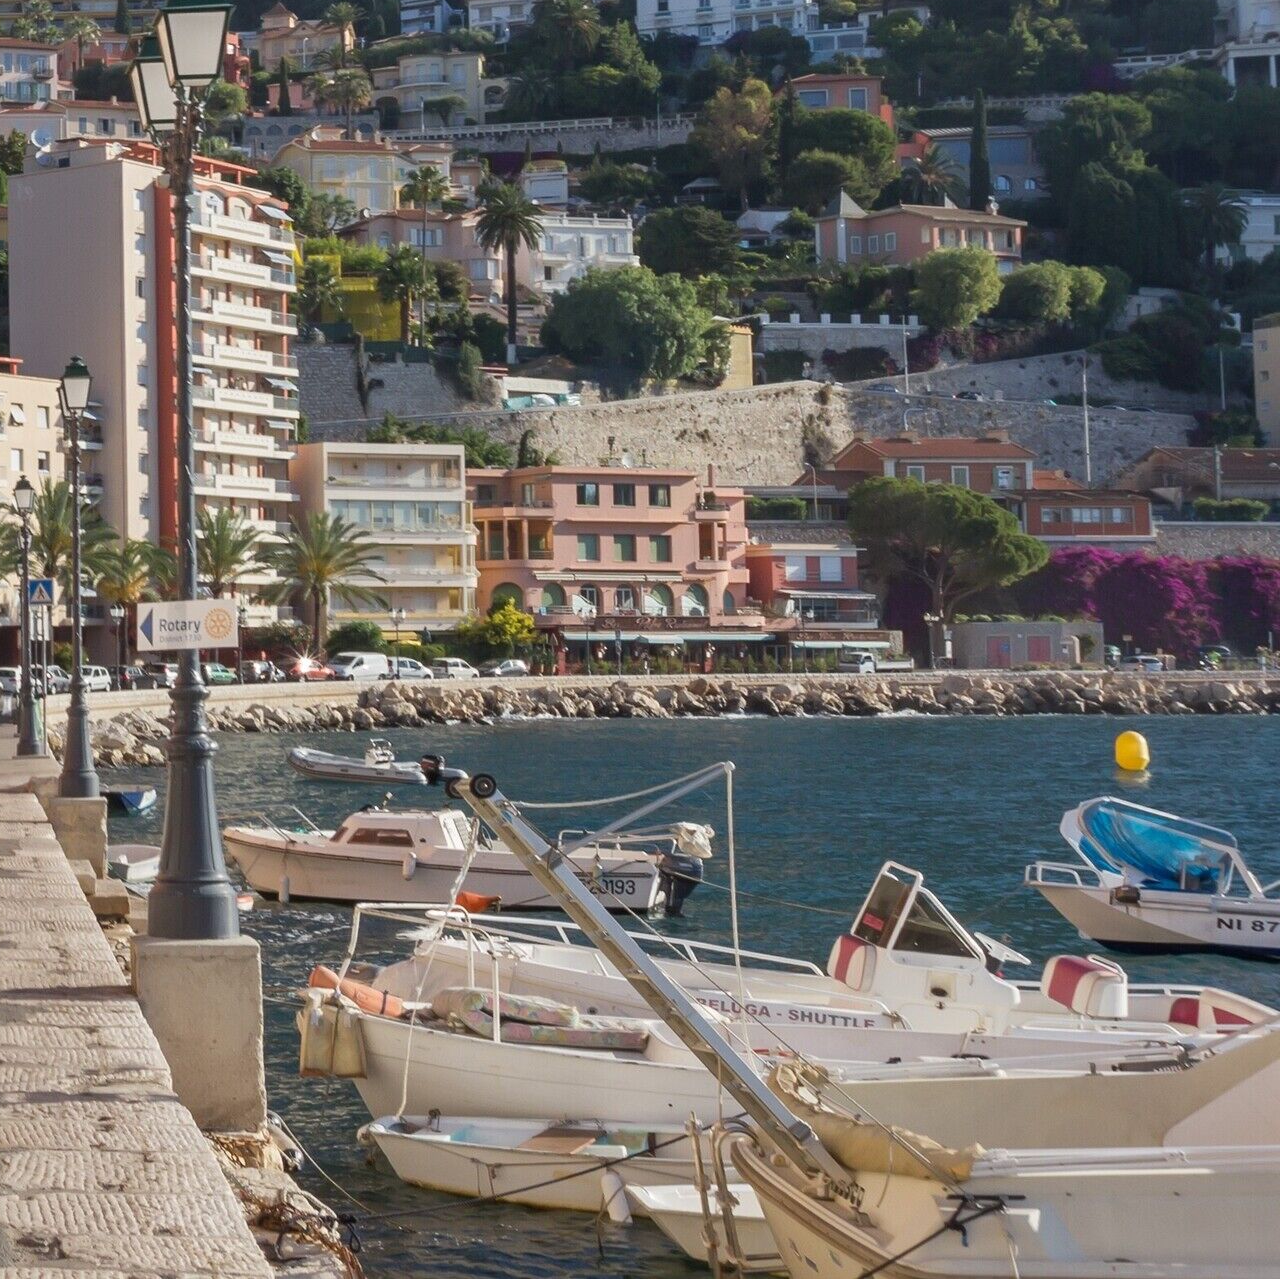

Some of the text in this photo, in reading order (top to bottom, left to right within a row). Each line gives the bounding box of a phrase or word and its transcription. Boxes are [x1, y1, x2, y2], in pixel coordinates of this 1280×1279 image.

[159, 619, 201, 633] Rotary
[1217, 917, 1242, 931] NI
[788, 1009, 876, 1029] SHUTTLE
